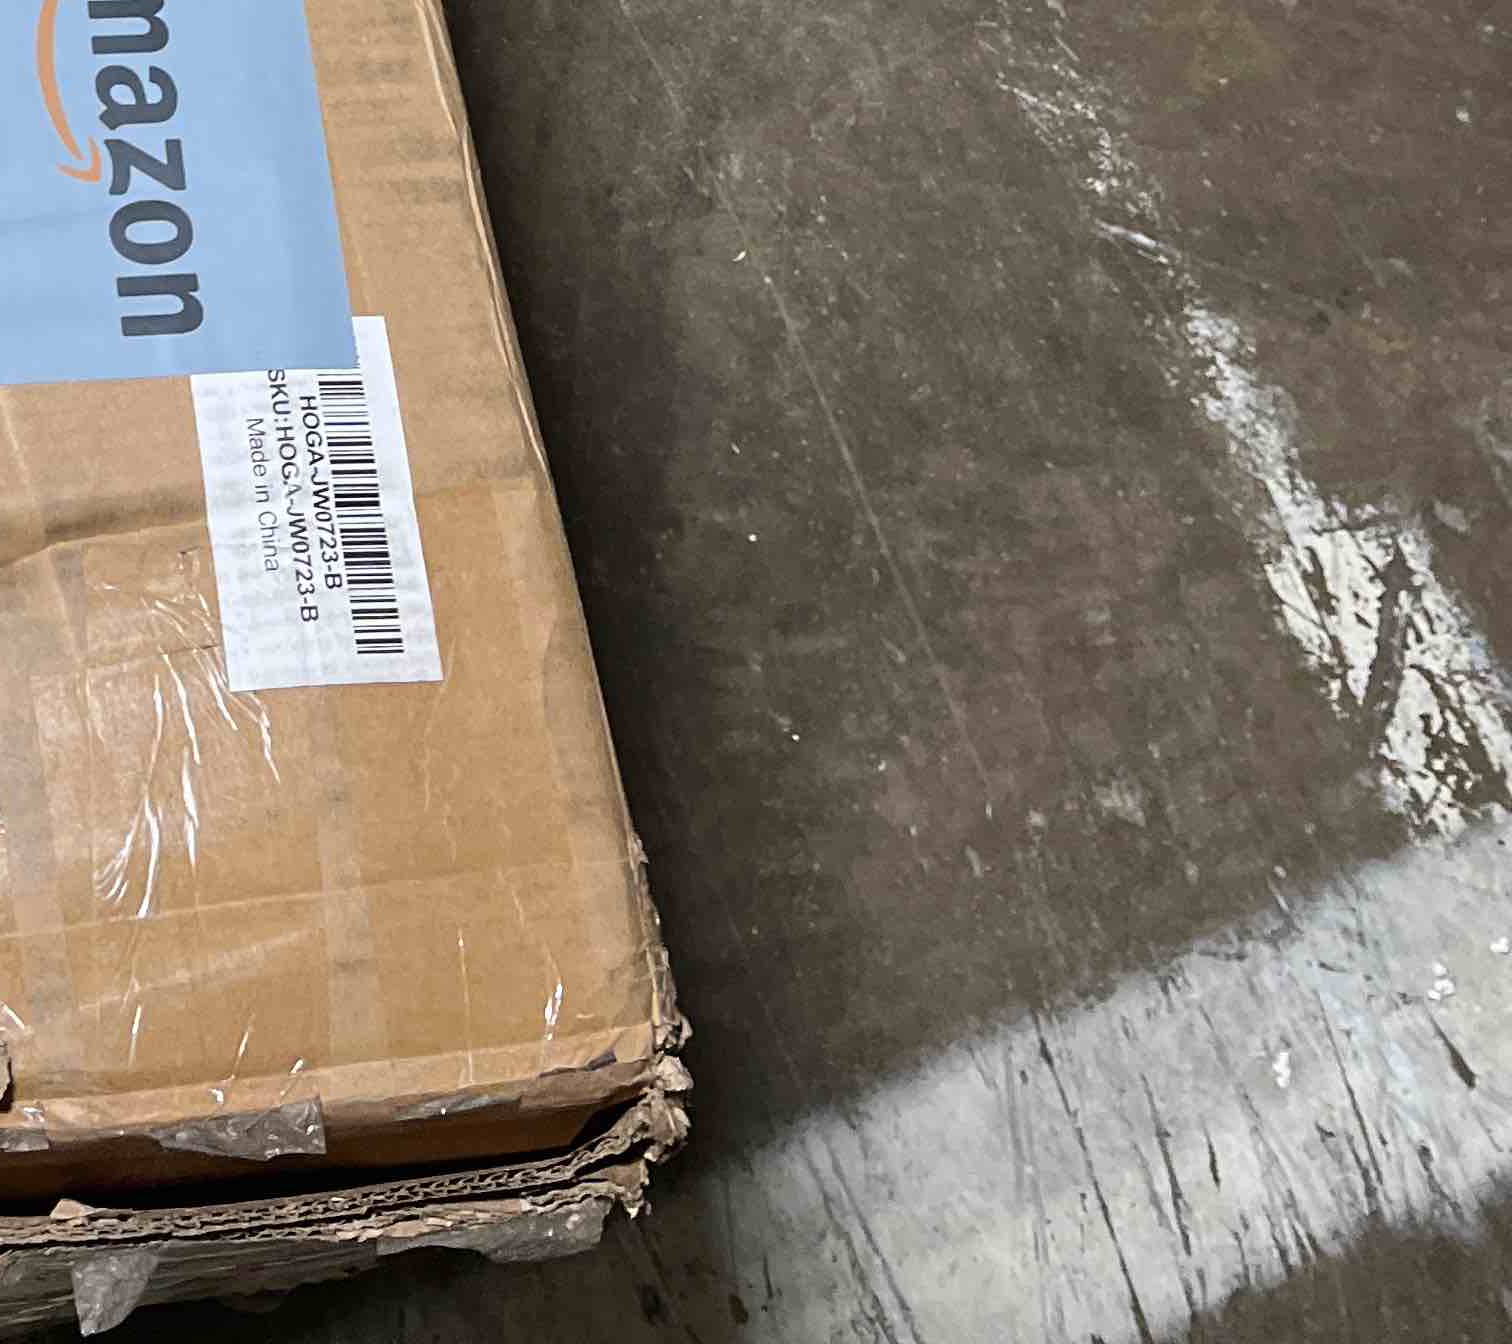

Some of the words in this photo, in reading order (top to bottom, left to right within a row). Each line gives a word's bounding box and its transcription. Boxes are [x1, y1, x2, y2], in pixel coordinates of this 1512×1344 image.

[246, 417, 270, 478] Made
[255, 484, 270, 504] in
[298, 395, 344, 590] HOGA-JW0723-B
[258, 511, 281, 572] China
